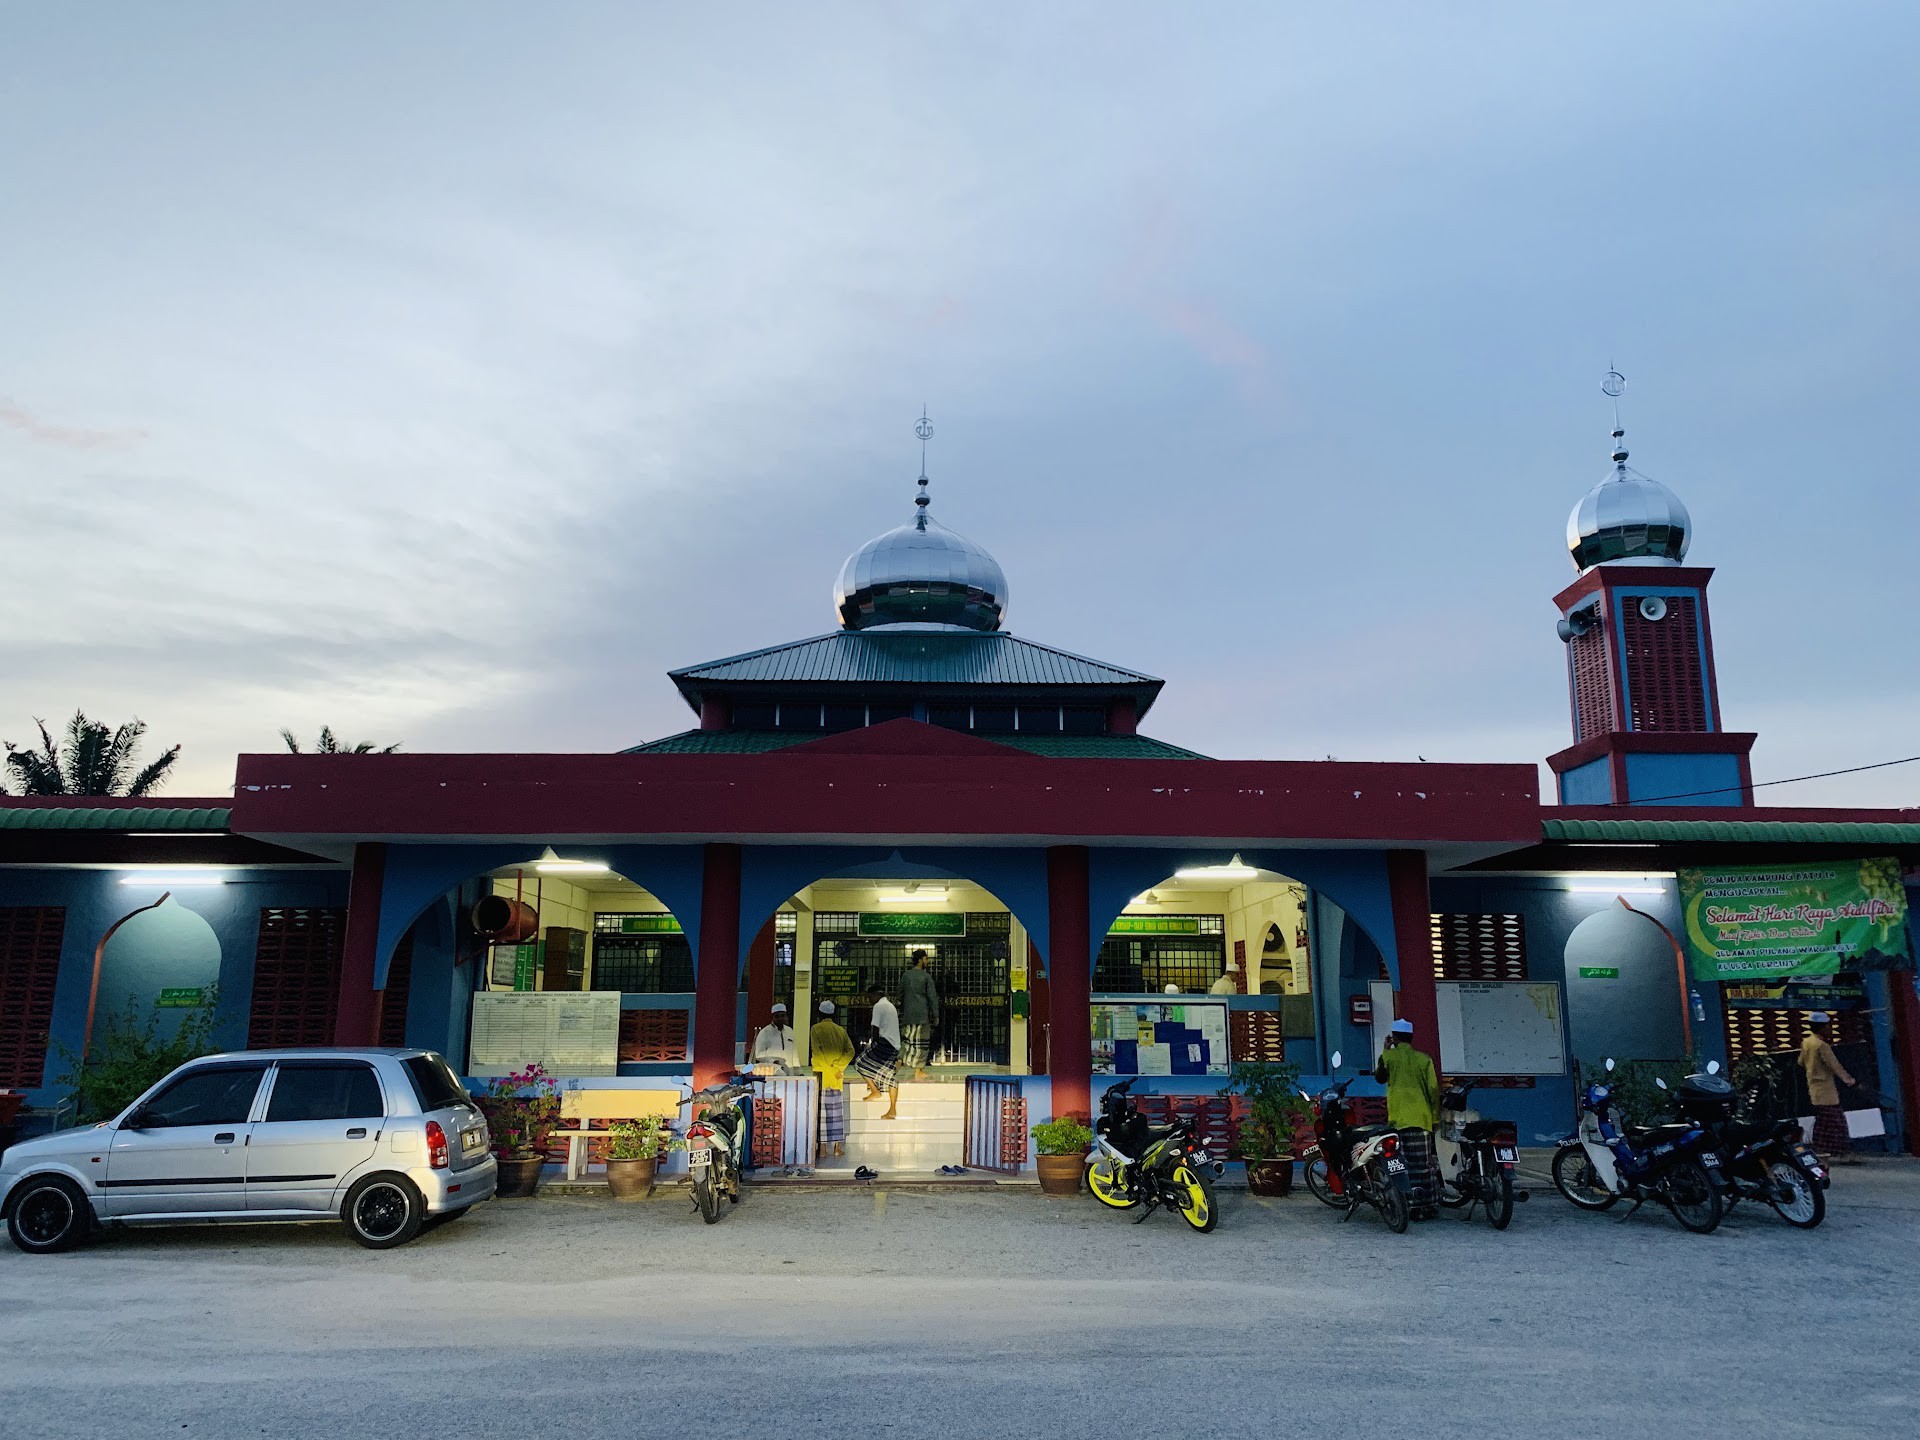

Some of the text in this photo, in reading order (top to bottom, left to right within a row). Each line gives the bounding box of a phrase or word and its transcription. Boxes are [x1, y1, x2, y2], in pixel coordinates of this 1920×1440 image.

[1703, 871, 1836, 885] PEMUDA KAMPUNG BATU 14
[1706, 899, 1895, 931] Selamat Hari Raya Aidilfitri
[1717, 930, 1743, 945] Maaf
[1768, 928, 1788, 939] Dan
[1715, 948, 1757, 958] SELAMAT
[1759, 946, 1796, 957] PULANG
[1755, 959, 1803, 969] TERCINTA
[1388, 1163, 1405, 1172] 2732
